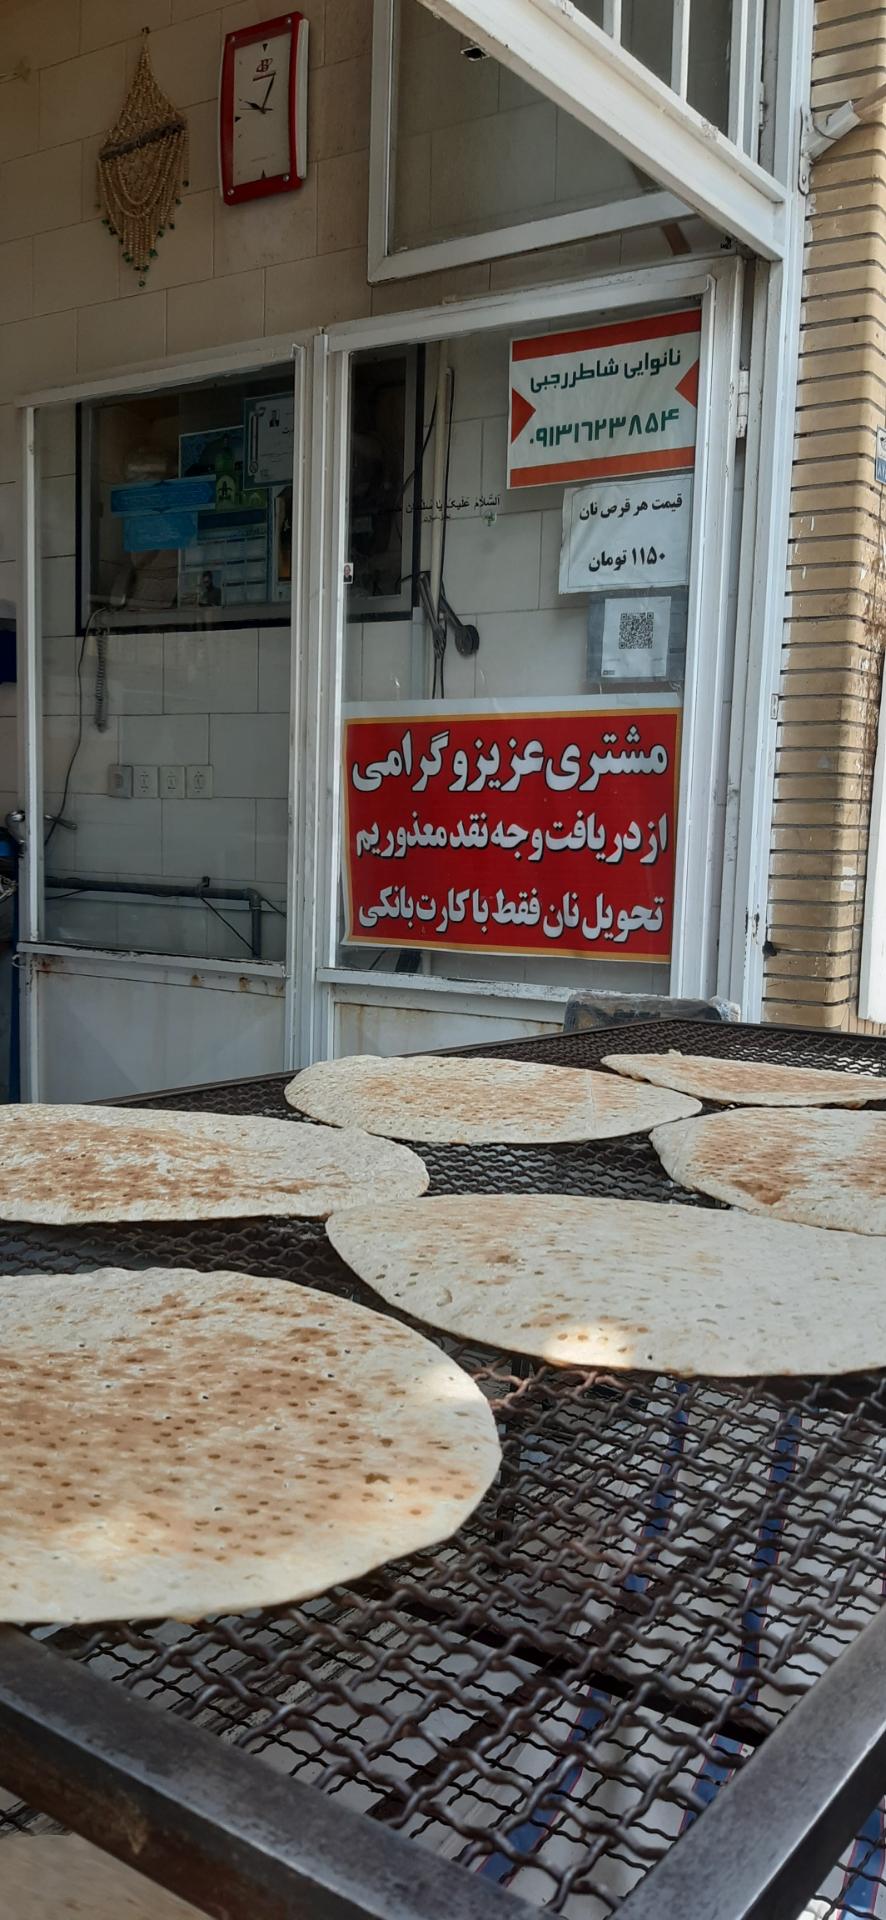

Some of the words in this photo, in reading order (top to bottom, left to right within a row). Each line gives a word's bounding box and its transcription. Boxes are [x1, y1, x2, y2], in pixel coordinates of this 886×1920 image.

[624, 348, 681, 379] نانوایی
[579, 501, 598, 520] نان
[600, 498, 630, 518] قرص
[633, 500, 648, 516] هر
[651, 493, 683, 512] قیمت
[588, 550, 627, 572] تومان
[631, 546, 666, 565] ۱۱۵۰
[352, 730, 450, 792] گرامی
[449, 749, 469, 792] و
[467, 737, 545, 792] عزیز
[545, 725, 668, 792] مشتری
[355, 811, 448, 857] معذوریم
[449, 812, 489, 849] نقد
[491, 820, 543, 861] وجه
[545, 810, 641, 863] دریافت
[640, 812, 667, 864] از
[359, 885, 414, 928] بانکی
[415, 888, 470, 932] کارت
[472, 889, 489, 933] با
[491, 888, 541, 925] فقط
[542, 891, 580, 938] نان
[582, 893, 665, 942] تحویل
